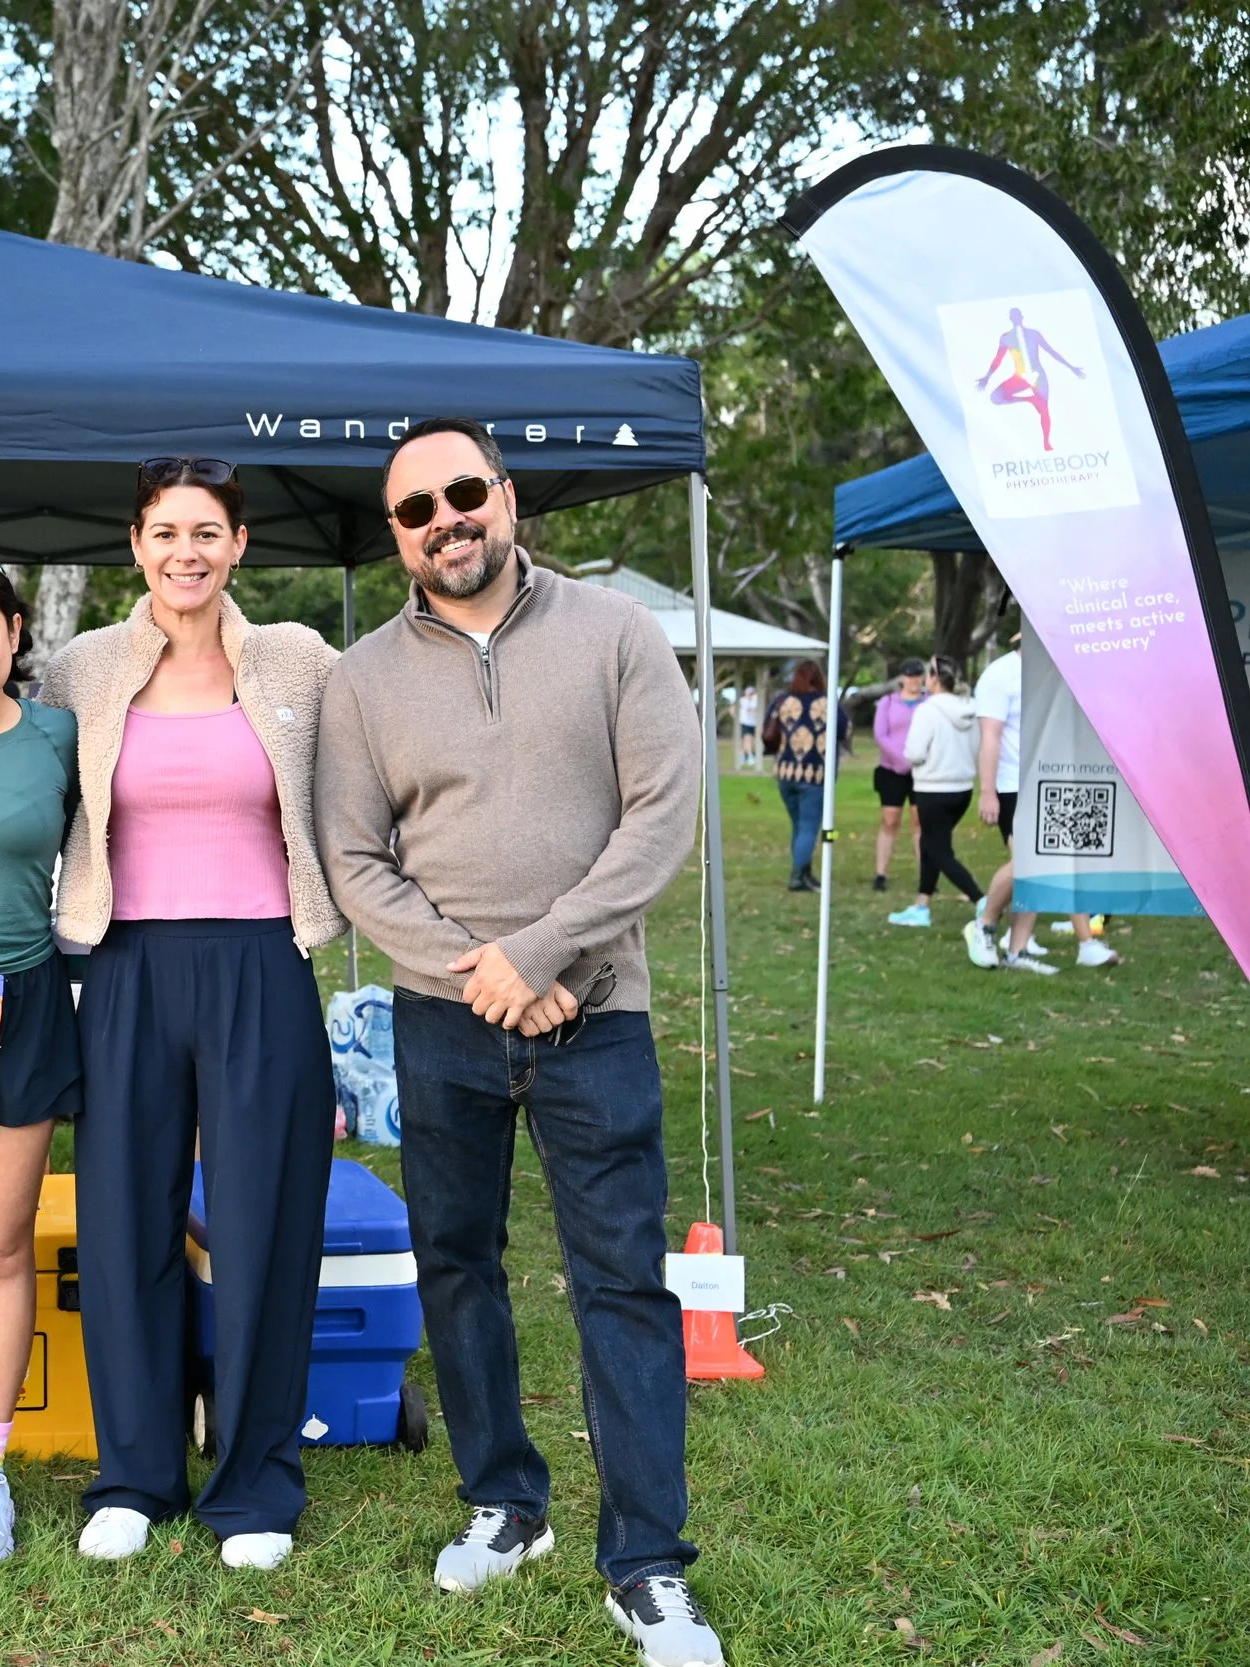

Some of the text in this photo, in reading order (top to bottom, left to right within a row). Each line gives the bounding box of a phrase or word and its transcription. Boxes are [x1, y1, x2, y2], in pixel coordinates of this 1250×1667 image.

[245, 412, 585, 444] Wandrer
[992, 450, 1110, 478] PRIMEBODY
[1006, 471, 1100, 490] PHYSIOTHERAPY
[1065, 591, 1179, 615] clinical care,
[1070, 610, 1186, 635] meets active
[1074, 629, 1156, 655] recovery"
[1038, 760, 1076, 773] learn
[691, 1281, 719, 1290] Dalton
